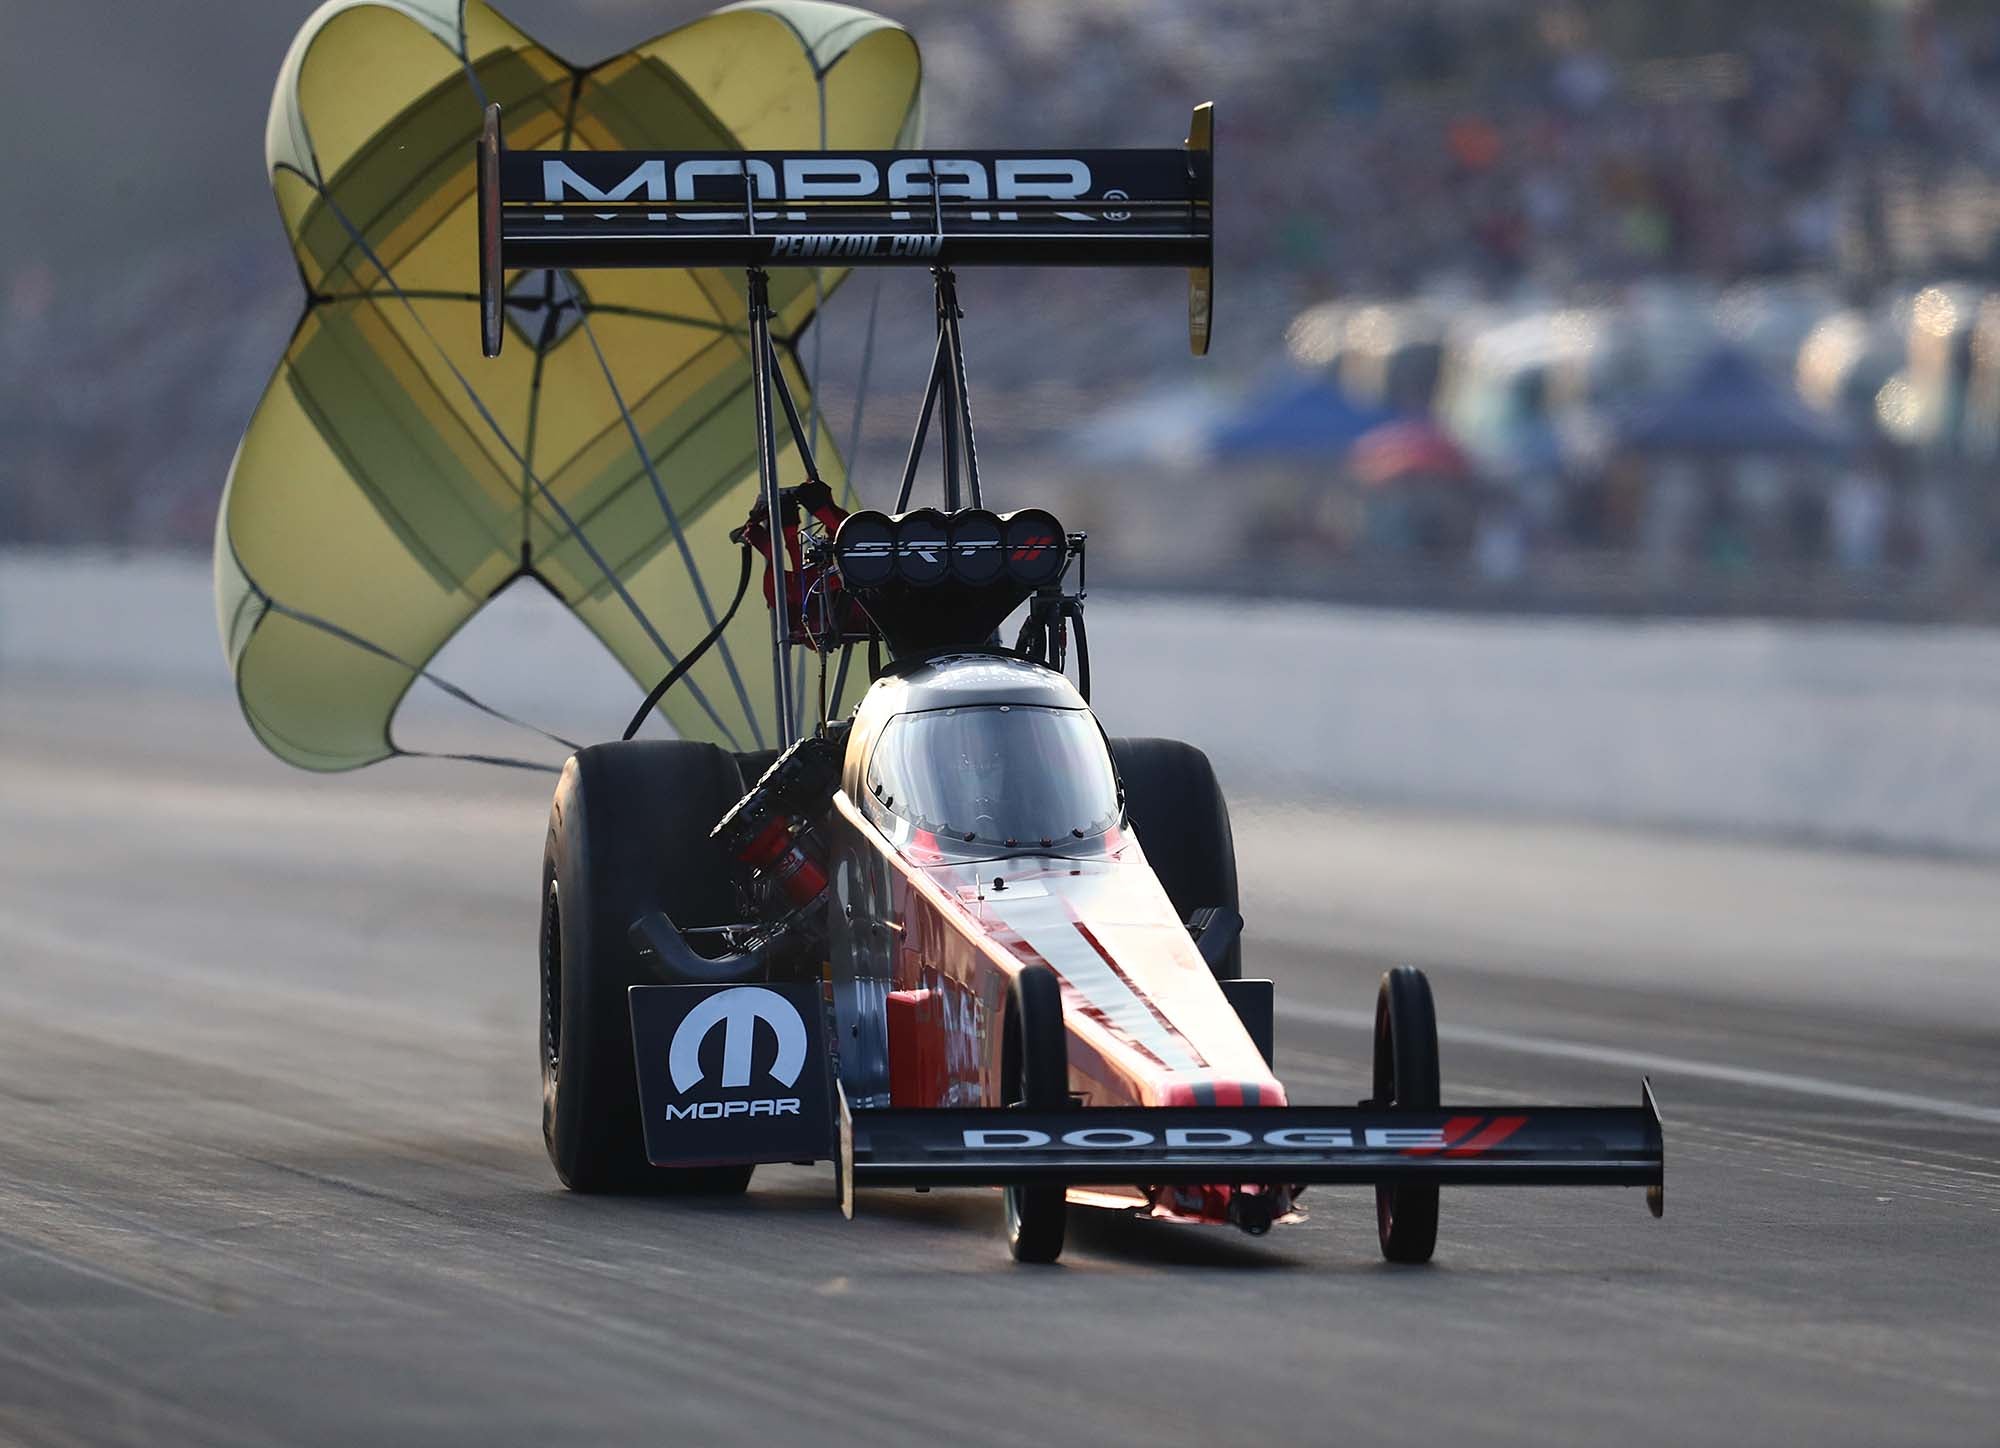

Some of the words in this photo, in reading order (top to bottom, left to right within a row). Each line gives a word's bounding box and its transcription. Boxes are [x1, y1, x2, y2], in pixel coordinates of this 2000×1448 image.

[542, 159, 1097, 221] MOPAR
[771, 235, 944, 257] PENNZOIL.COM
[665, 1098, 801, 1121] MOPAR
[962, 1128, 1448, 1148] DODGE
